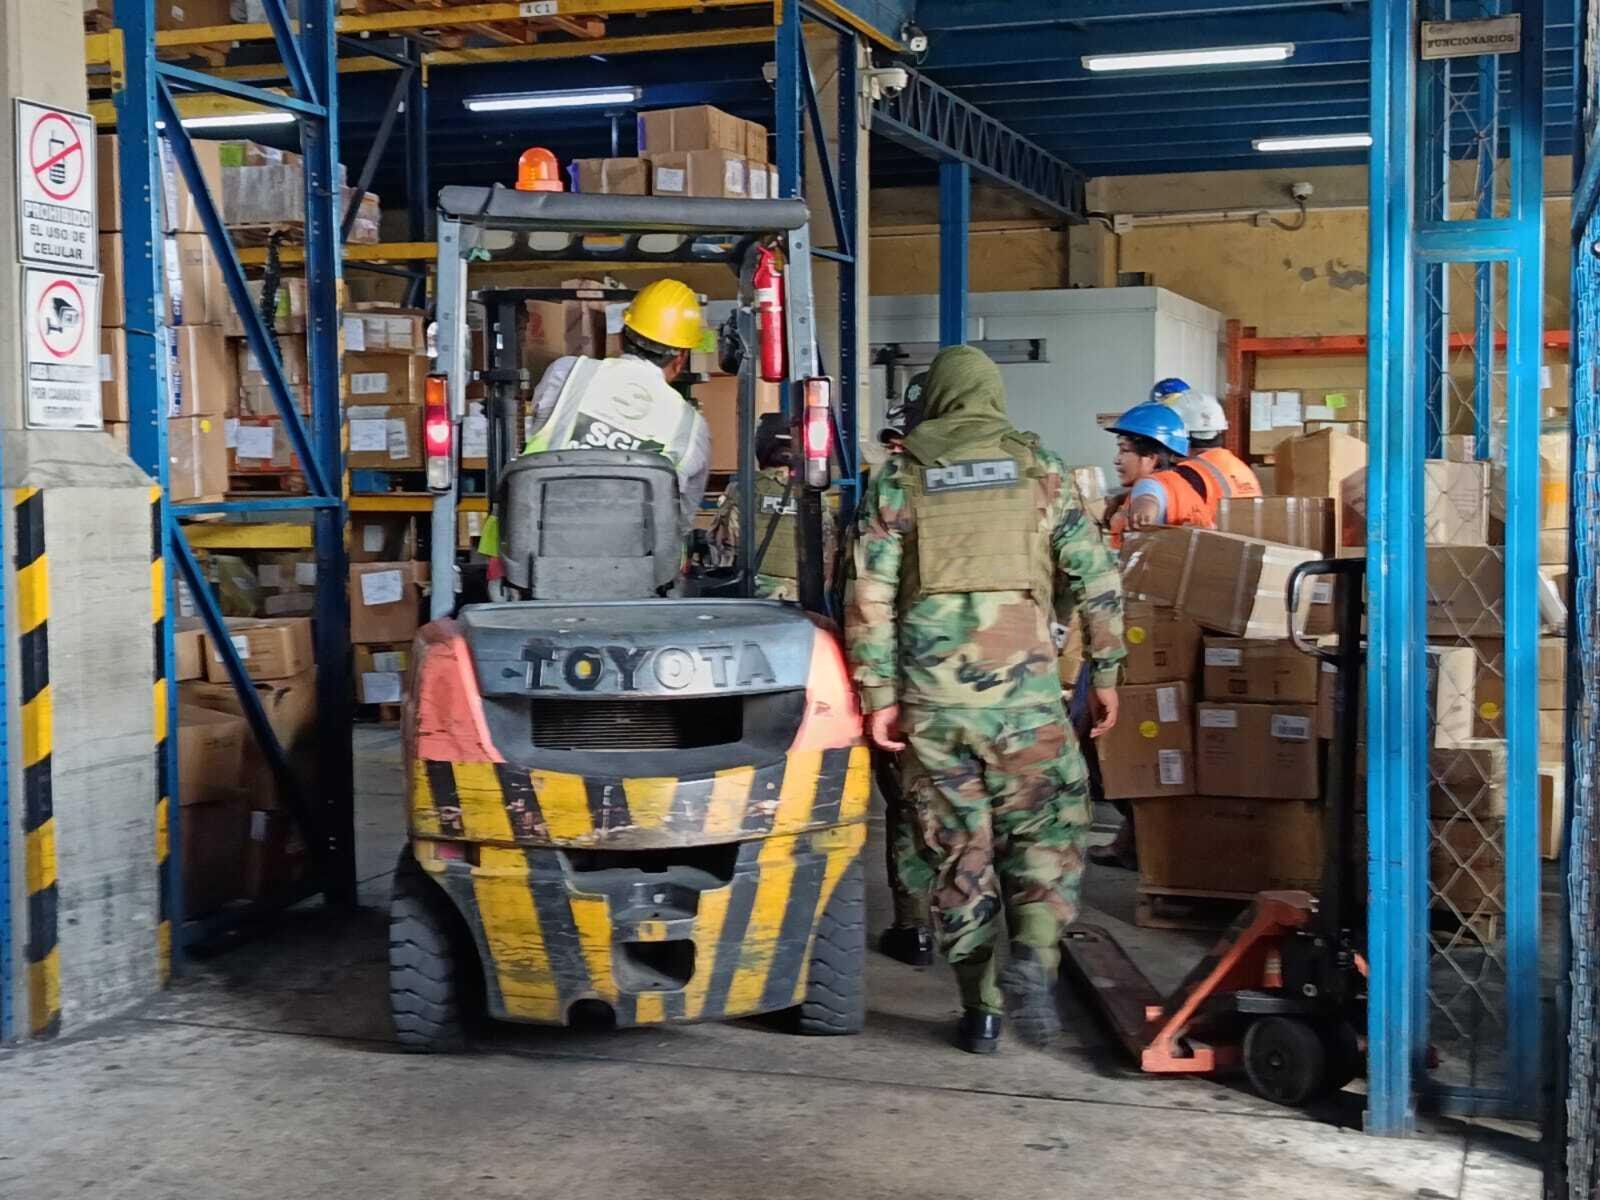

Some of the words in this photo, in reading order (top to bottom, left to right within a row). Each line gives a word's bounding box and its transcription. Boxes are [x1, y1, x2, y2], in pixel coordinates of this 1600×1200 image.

[1428, 34, 1514, 48] FUNCIONARIOS
[30, 224, 43, 236] EL
[46, 226, 68, 240] USO
[72, 231, 86, 243] DE
[34, 242, 82, 259] CELULAR
[519, 640, 776, 691] TOYOTA
